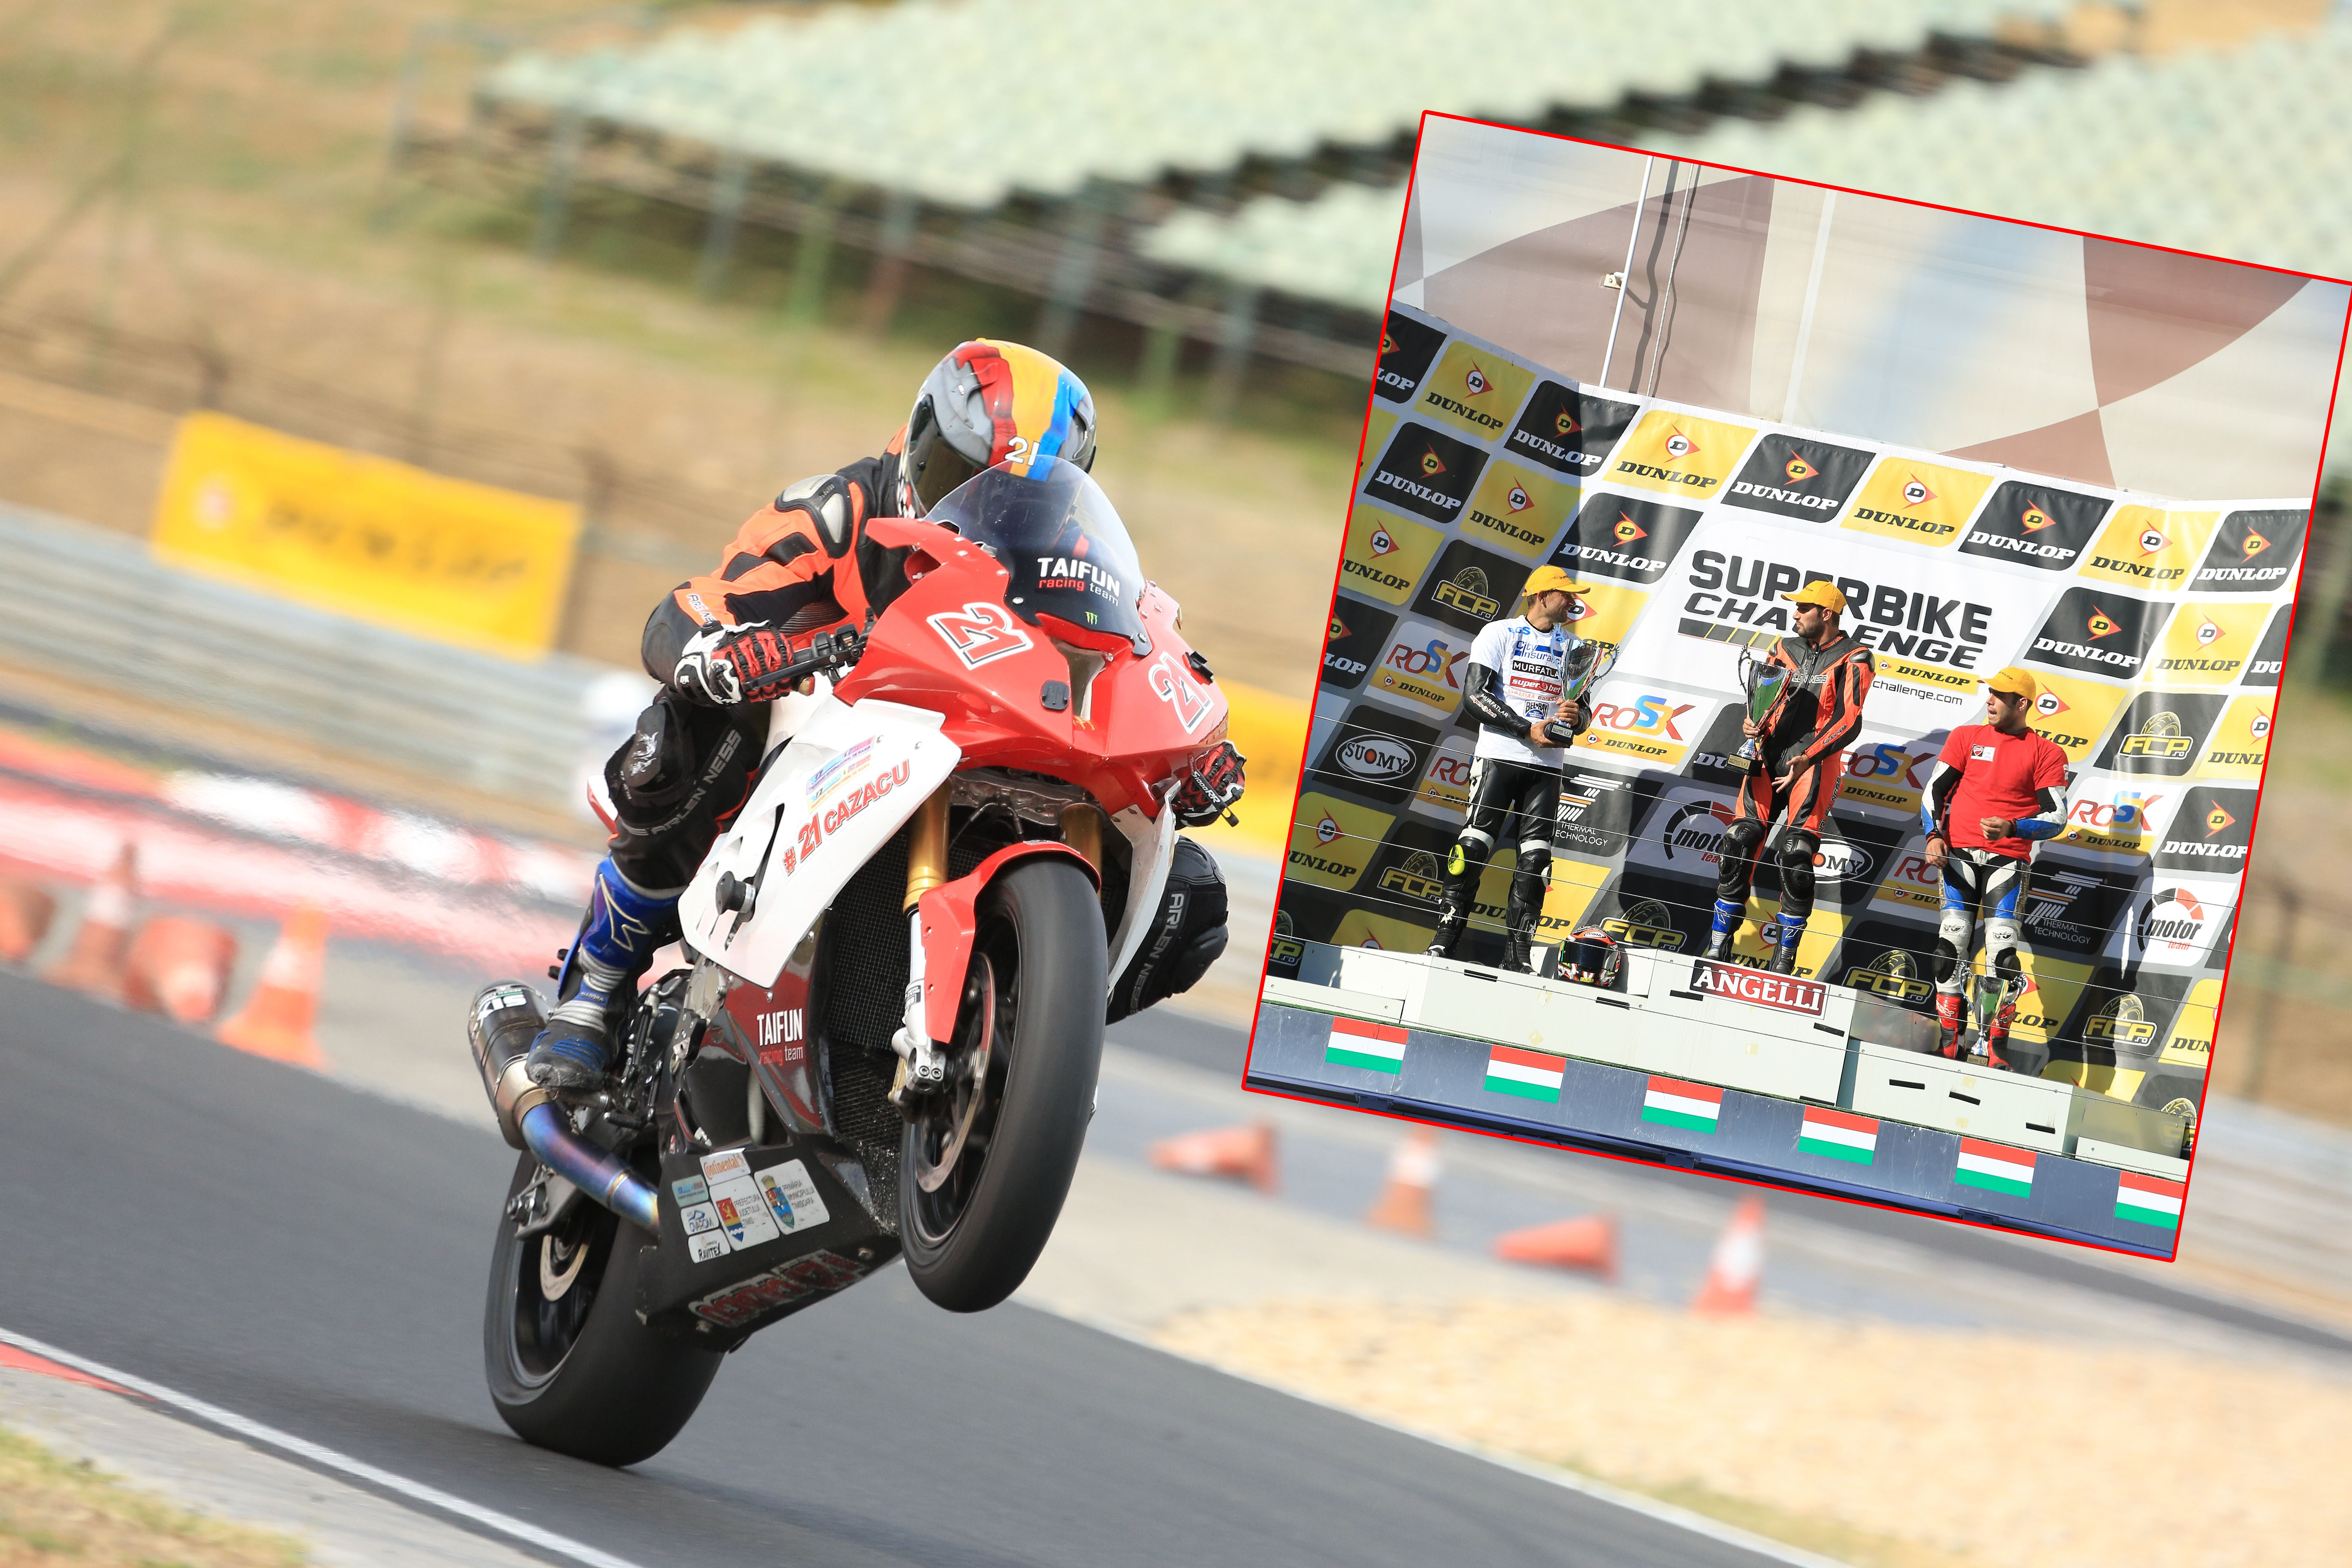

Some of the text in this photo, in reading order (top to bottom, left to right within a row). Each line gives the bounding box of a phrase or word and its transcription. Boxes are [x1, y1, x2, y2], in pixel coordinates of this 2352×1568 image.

[1425, 392, 1503, 430] DUNLOP
[1004, 436, 1041, 467] 21
[1513, 429, 1602, 466] DUNLOP
[1617, 461, 1717, 488] DUNLOP
[1375, 470, 1461, 510] DUNLOP
[1731, 481, 1839, 510] DUNLOP
[1470, 510, 1545, 546] DUNLOP
[1854, 508, 1955, 535] DUNLOP
[1559, 543, 1667, 572] DUNLOP
[1967, 531, 2076, 560] DUNLOP
[1037, 557, 1120, 597] TAIFUN
[1341, 557, 1410, 591] UNLOP
[2090, 556, 2185, 580] DUNLOP
[2196, 567, 2287, 581] DUNLOP
[1038, 578, 1119, 607] racing team
[1435, 582, 1498, 616] FCP
[926, 602, 1033, 671] 21
[1684, 592, 1983, 669] CHAENGE
[2033, 637, 2142, 668] DUNLOP
[2156, 659, 2241, 671] DUNLOP
[1809, 675, 1828, 684] NESS
[1896, 666, 1970, 686] DUNLOP
[1147, 651, 1215, 735] 21
[1398, 682, 1446, 702] DUNLOP
[1480, 693, 1508, 718] MURFATLAR
[1870, 680, 1962, 706] challenge.com
[1591, 695, 1696, 741] ROSBK
[1604, 739, 1667, 755] DUNLOP
[1823, 724, 1846, 745] ARLEN NESS
[2124, 737, 2190, 756] FCP
[1345, 742, 1408, 773] SUOMY
[651, 730, 742, 835] ARLEN NESS
[1192, 771, 1221, 803] S1000RR
[1831, 776, 1841, 803] NESS
[1844, 786, 1907, 804] DUNLOP
[824, 759, 910, 835] CAZACU
[2068, 791, 2164, 831] ROSBK
[1561, 822, 1597, 835] THERMAL
[2085, 836, 2140, 849] DUNLOP
[1287, 849, 1357, 877] UNLOP
[2161, 841, 2248, 859] DUNLOP
[1149, 893, 1185, 958] ARLEN
[1602, 921, 1683, 949] FCP
[2034, 927, 2090, 944] TECHNOLOGY
[2043, 919, 2079, 933] THERMAL
[2145, 918, 2203, 940] motor
[2167, 940, 2191, 951] team
[1693, 966, 1823, 1011] ANGELLI
[1849, 970, 1931, 998] FCP
[757, 1008, 803, 1047] TAIFUN
[2086, 1019, 2155, 1042] FCP
[758, 1045, 803, 1066] racing team
